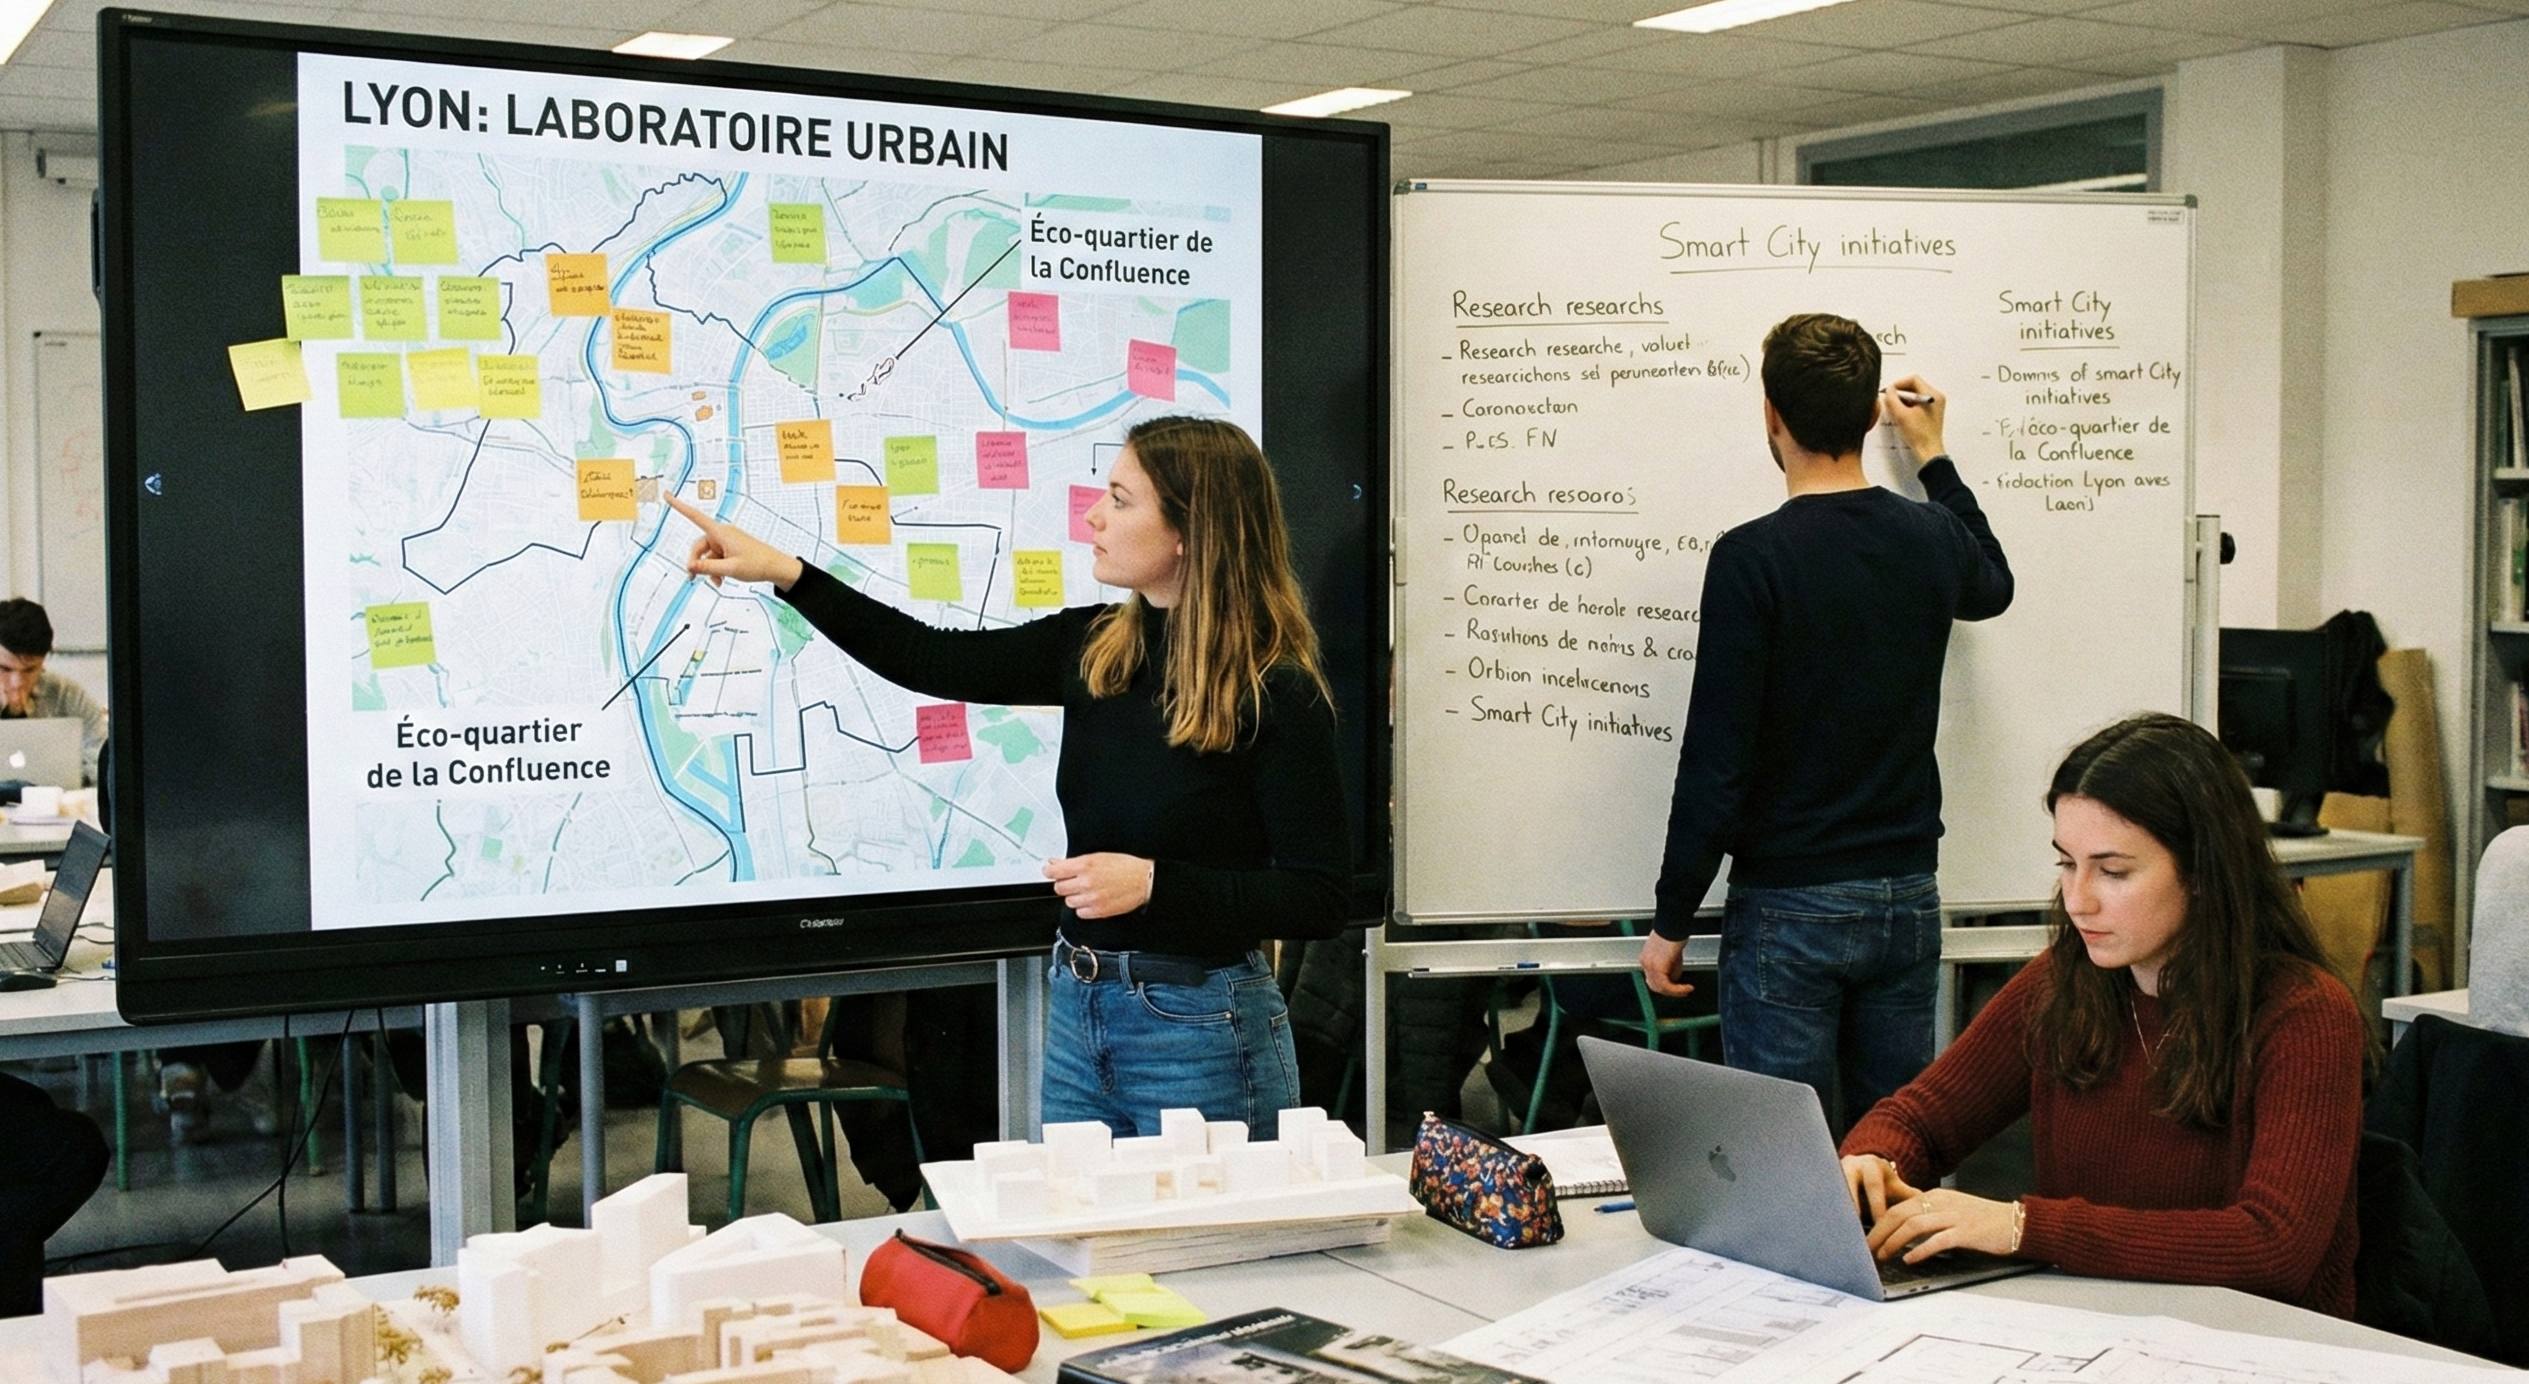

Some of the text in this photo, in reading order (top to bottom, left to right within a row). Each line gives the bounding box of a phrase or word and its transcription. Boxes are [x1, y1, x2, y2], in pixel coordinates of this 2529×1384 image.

[345, 82, 1009, 171] LYON: LABORATOIRE URBAIN
[1031, 212, 1213, 253] Éco-quartier de
[1660, 221, 1957, 275] Smart City initiatives
[1031, 255, 1191, 286] la Confluence
[1453, 289, 1665, 318] Research researchs
[1999, 290, 2112, 323] Smart City
[2020, 318, 2115, 341] initiatives
[1460, 338, 1537, 360] Research
[2070, 361, 2088, 383] of
[2096, 362, 2144, 382] smart
[2149, 361, 2182, 390] City
[2025, 386, 2111, 405] initiatives
[2148, 415, 2171, 434] de
[2009, 440, 2135, 461] la Confluence
[1443, 478, 1536, 504] Research
[2084, 470, 2125, 497] Lyon
[1548, 592, 1569, 613] de
[1558, 629, 1578, 651] de
[1643, 636, 1658, 658] &
[397, 714, 583, 751] Éco-quartier
[1471, 695, 1673, 743] Smart City initiatives
[367, 756, 611, 789] de la Confluence
